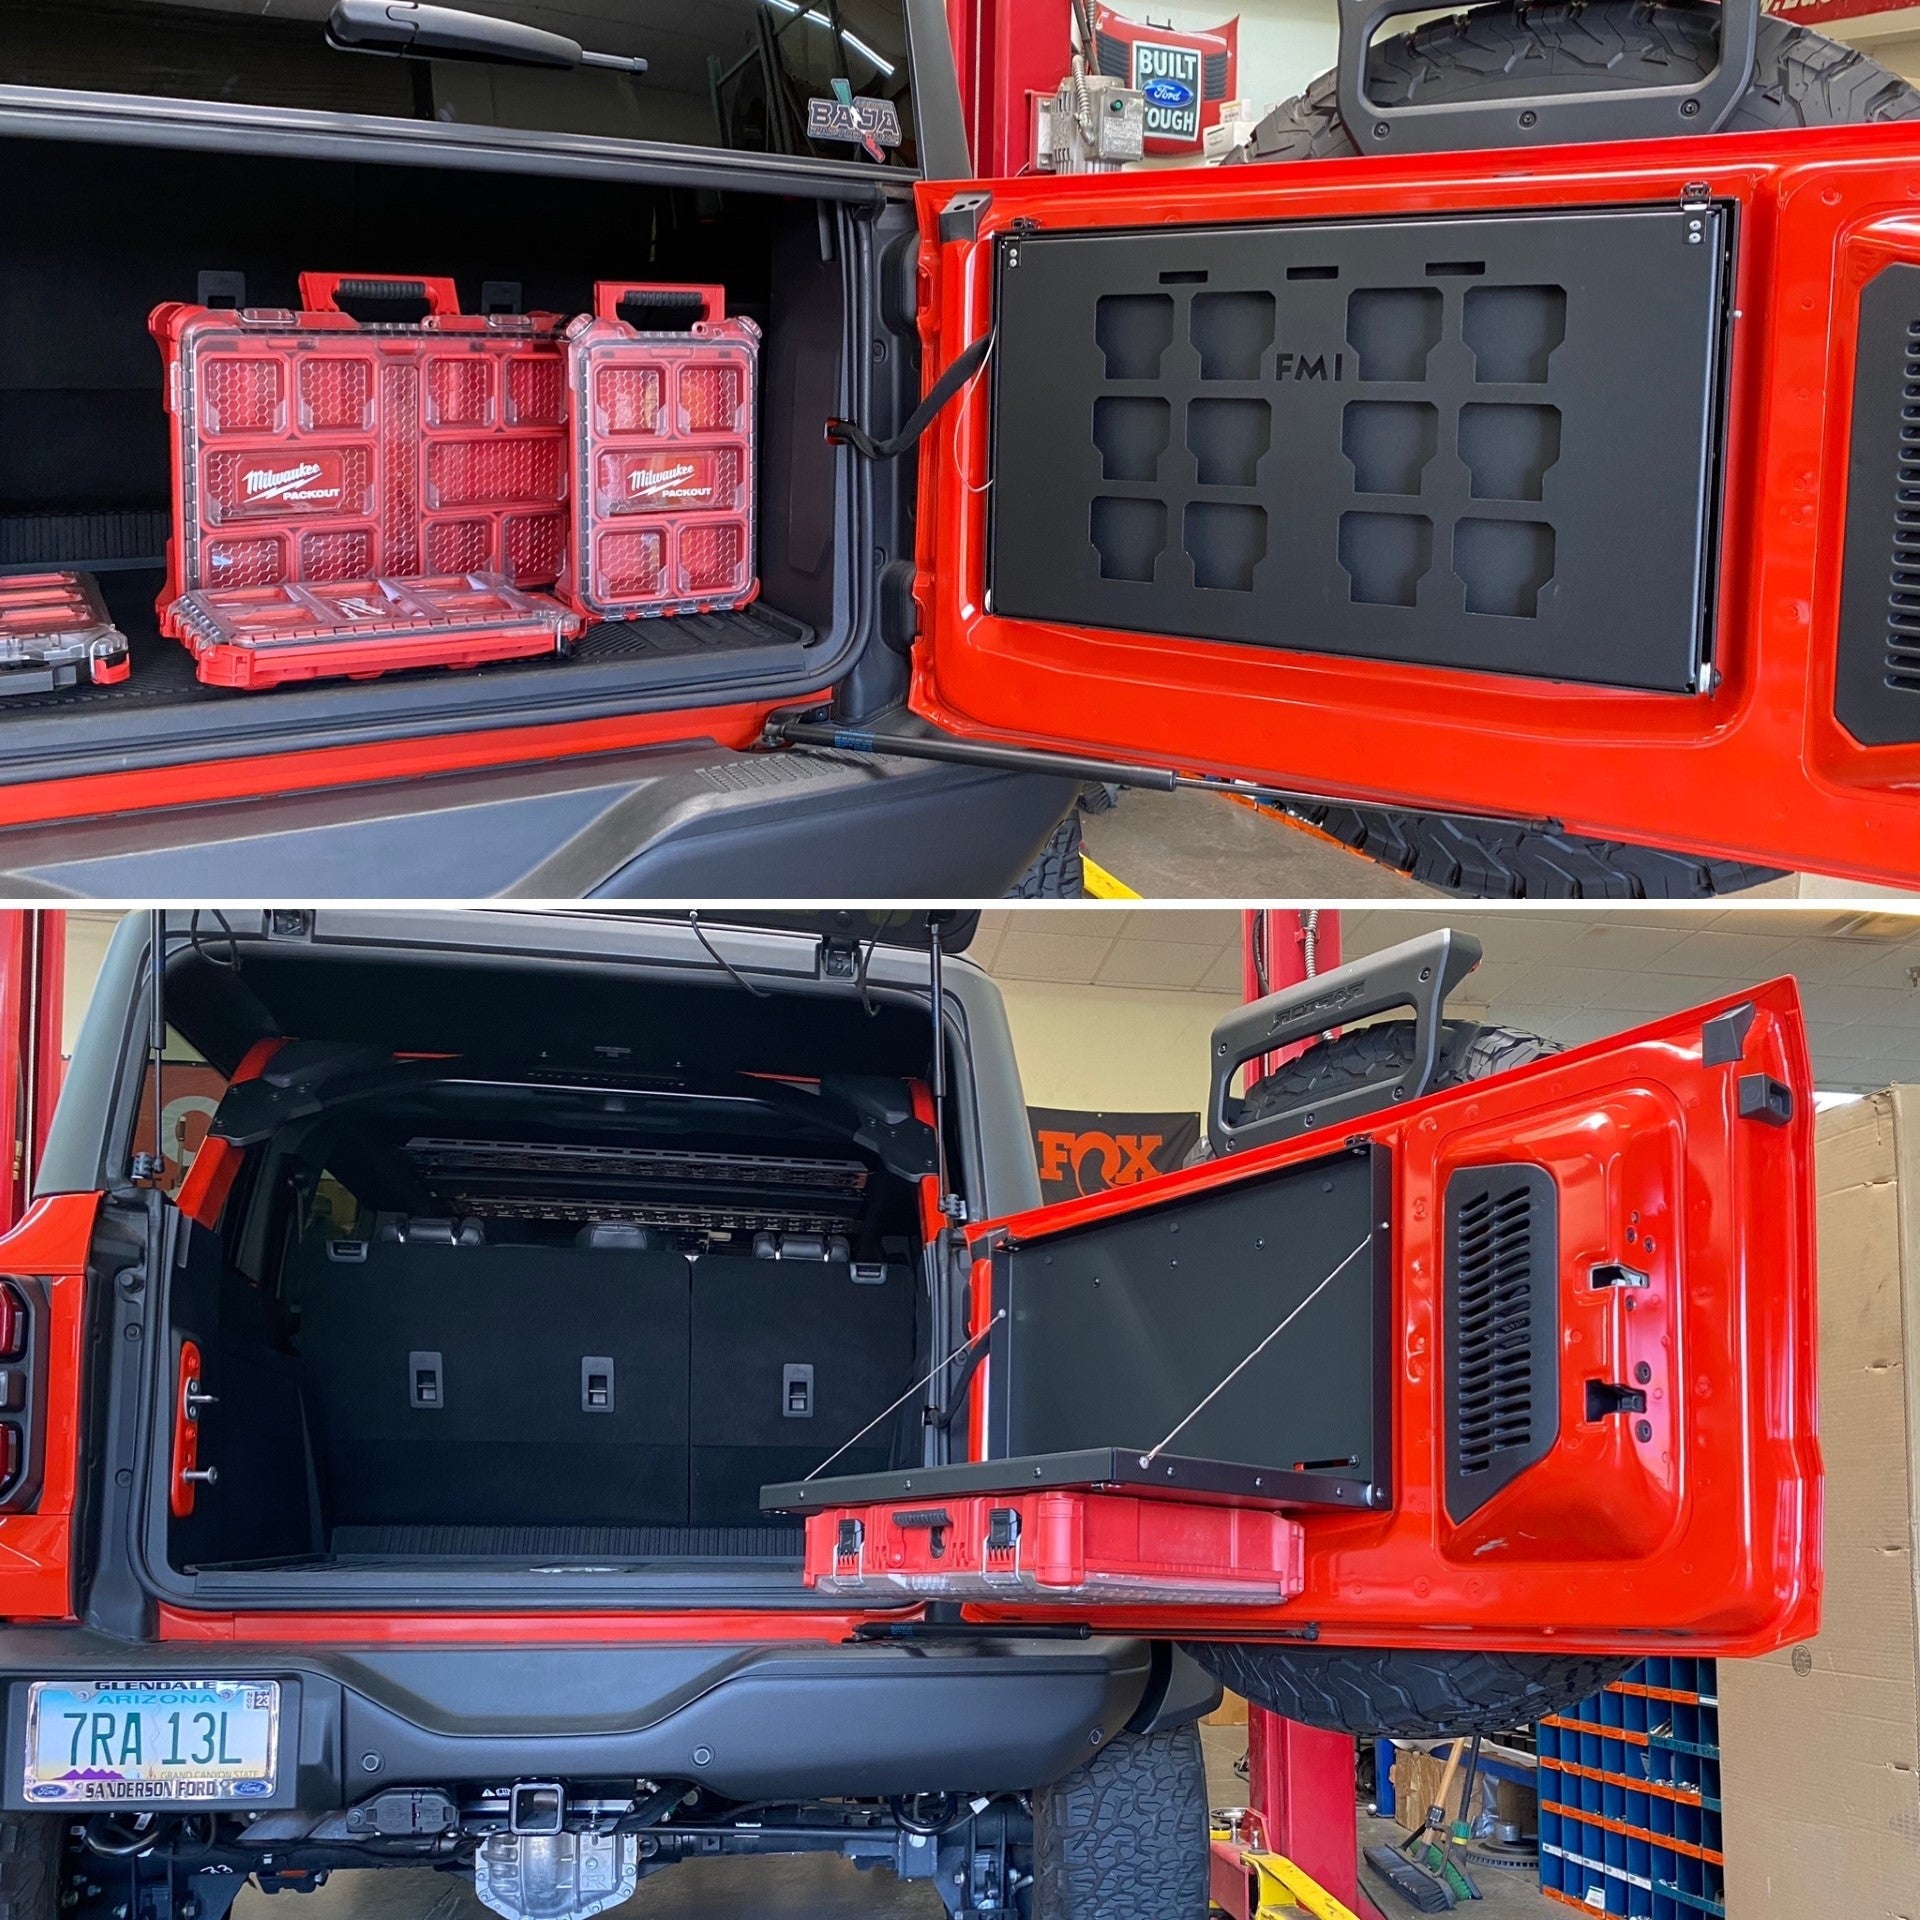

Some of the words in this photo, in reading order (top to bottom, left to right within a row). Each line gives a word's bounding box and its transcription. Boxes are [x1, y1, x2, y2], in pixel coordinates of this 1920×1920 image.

[1138, 48, 1197, 80] BUILT
[1153, 84, 1181, 102] Ford
[1144, 106, 1194, 132] OUGH
[1275, 353, 1343, 381] FMI
[241, 462, 321, 495] Milwaukee
[626, 464, 695, 491] Milwaukee
[282, 488, 340, 501] PACKOUT
[661, 487, 712, 498] PACKOUT
[1038, 1130, 1164, 1196] FOX
[94, 1681, 217, 1691] GLENDALE
[97, 1694, 217, 1704] ARIZONA
[255, 1694, 270, 1707] 23
[63, 1712, 142, 1766] 7RA
[161, 1711, 242, 1765] 13L
[160, 1771, 194, 1780] GRAND
[195, 1771, 232, 1779] CANYON
[233, 1770, 259, 1778] STATE
[37, 1786, 61, 1796] Ford
[85, 1782, 173, 1798] SANDERSON
[177, 1781, 216, 1797] FORD
[239, 1783, 262, 1793] Ford
